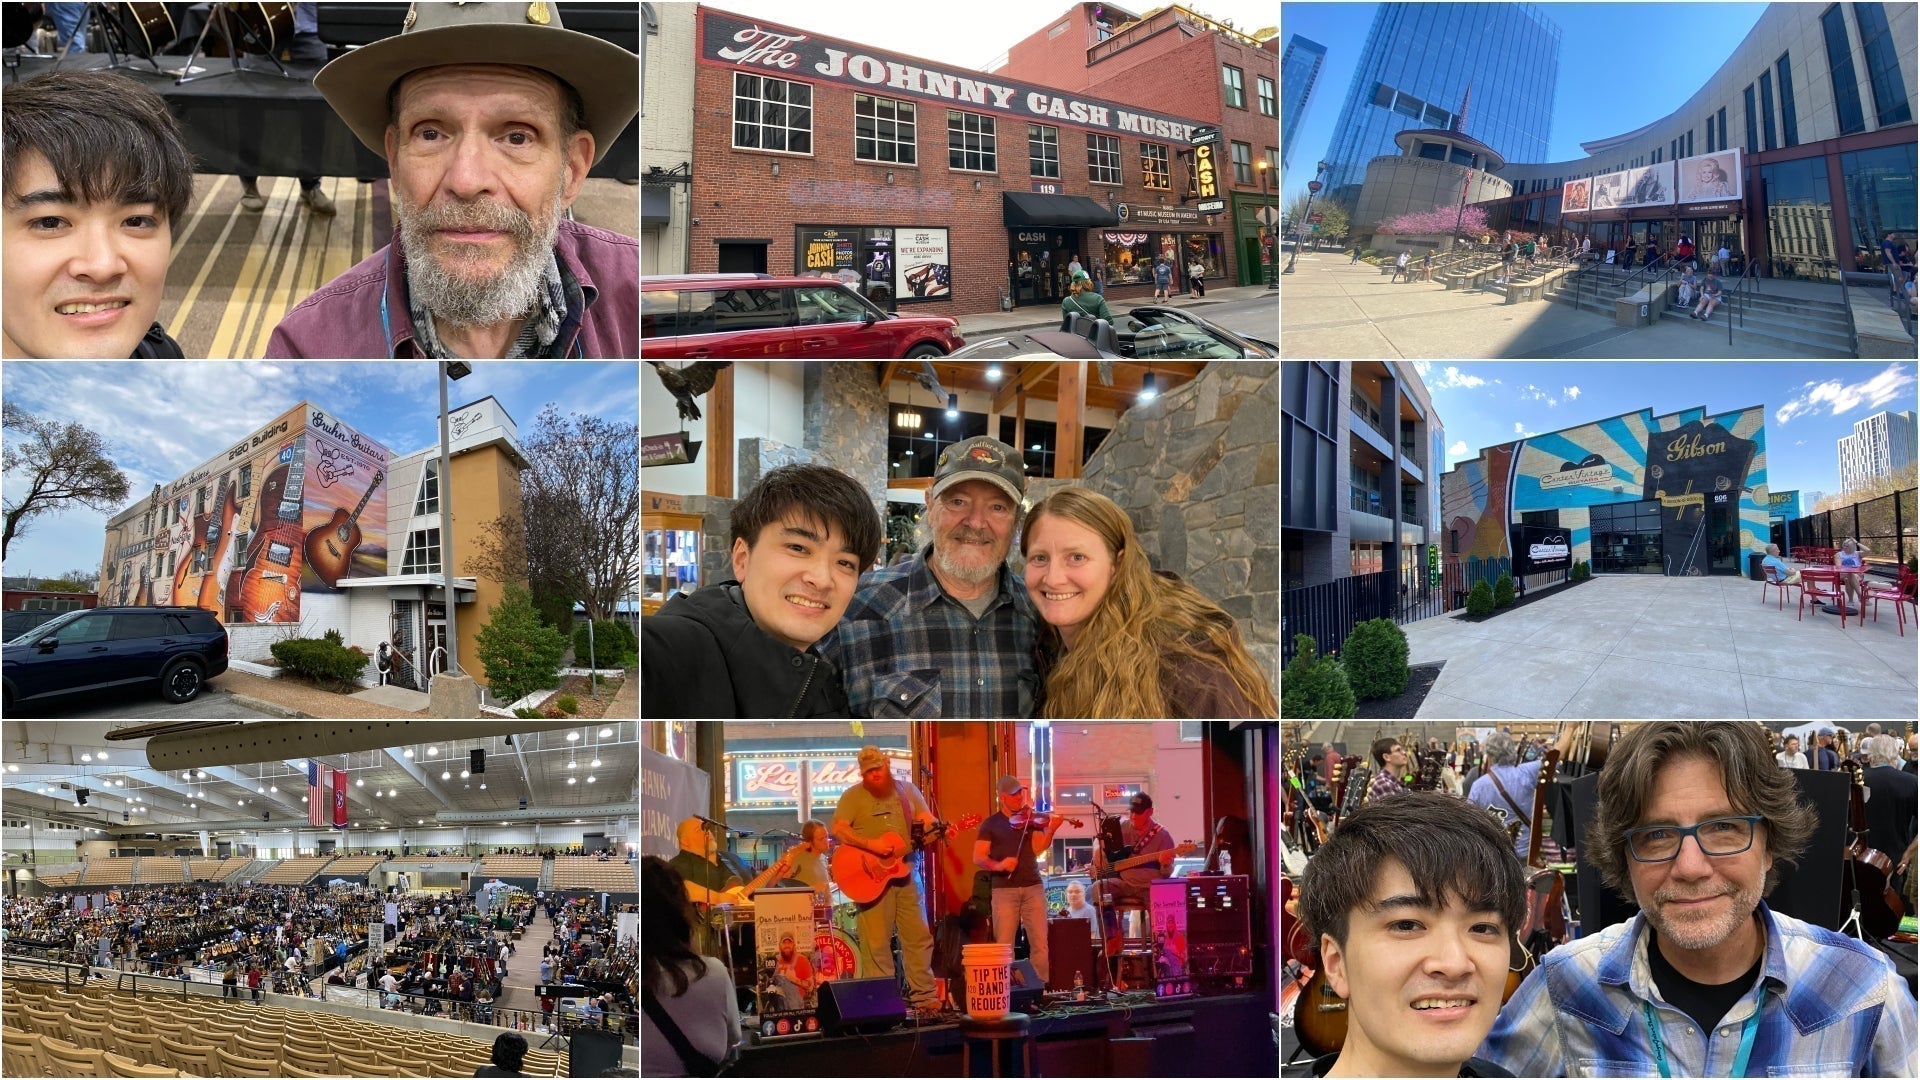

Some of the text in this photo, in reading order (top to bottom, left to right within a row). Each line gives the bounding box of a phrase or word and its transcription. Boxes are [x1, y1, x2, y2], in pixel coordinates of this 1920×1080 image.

[717, 24, 1197, 142] The JOHNNY CASH MUSEU
[1197, 145, 1215, 197] CASH
[1040, 185, 1055, 194] 119
[1018, 232, 1046, 242] CASH
[808, 242, 834, 255] JOHNNY
[807, 249, 834, 268] CASH
[228, 420, 288, 460] 2120 Building
[350, 433, 385, 462] Guitars
[1666, 433, 1727, 462] Gibson
[281, 448, 292, 461] 40
[641, 768, 667, 801] HANK
[973, 966, 1008, 982] TIP THE
[978, 981, 1004, 996] BAND
